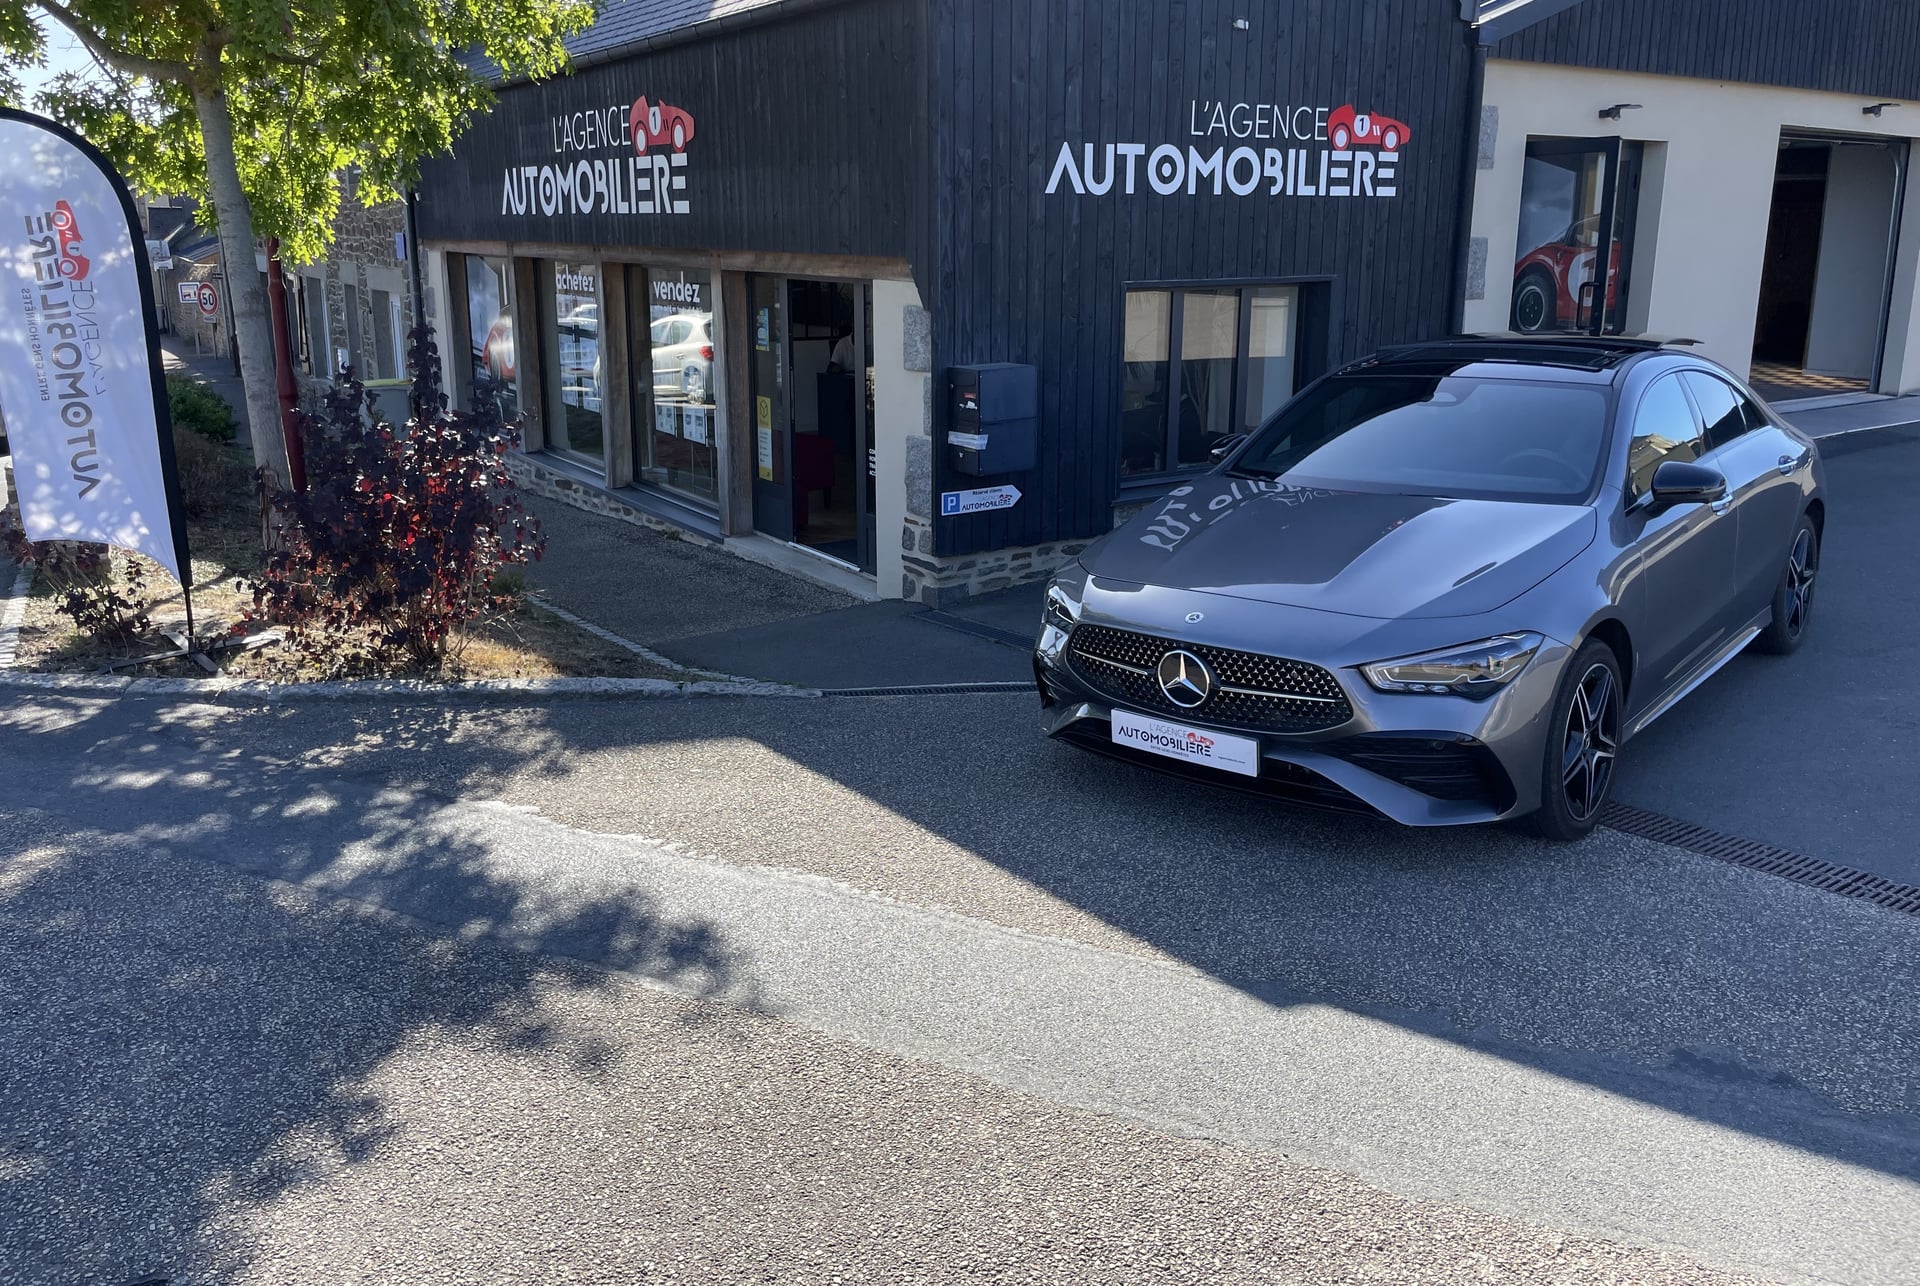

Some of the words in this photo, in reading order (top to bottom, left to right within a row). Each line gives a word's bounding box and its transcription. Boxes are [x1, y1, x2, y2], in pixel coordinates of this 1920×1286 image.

[552, 104, 632, 153] L'AGENCE
[1190, 99, 1329, 141] L'AGENCE
[555, 263, 595, 293] achetez
[653, 271, 700, 303] vendez
[202, 293, 215, 306] 50
[948, 497, 956, 511] P
[1150, 723, 1187, 739] L'AGENCE
